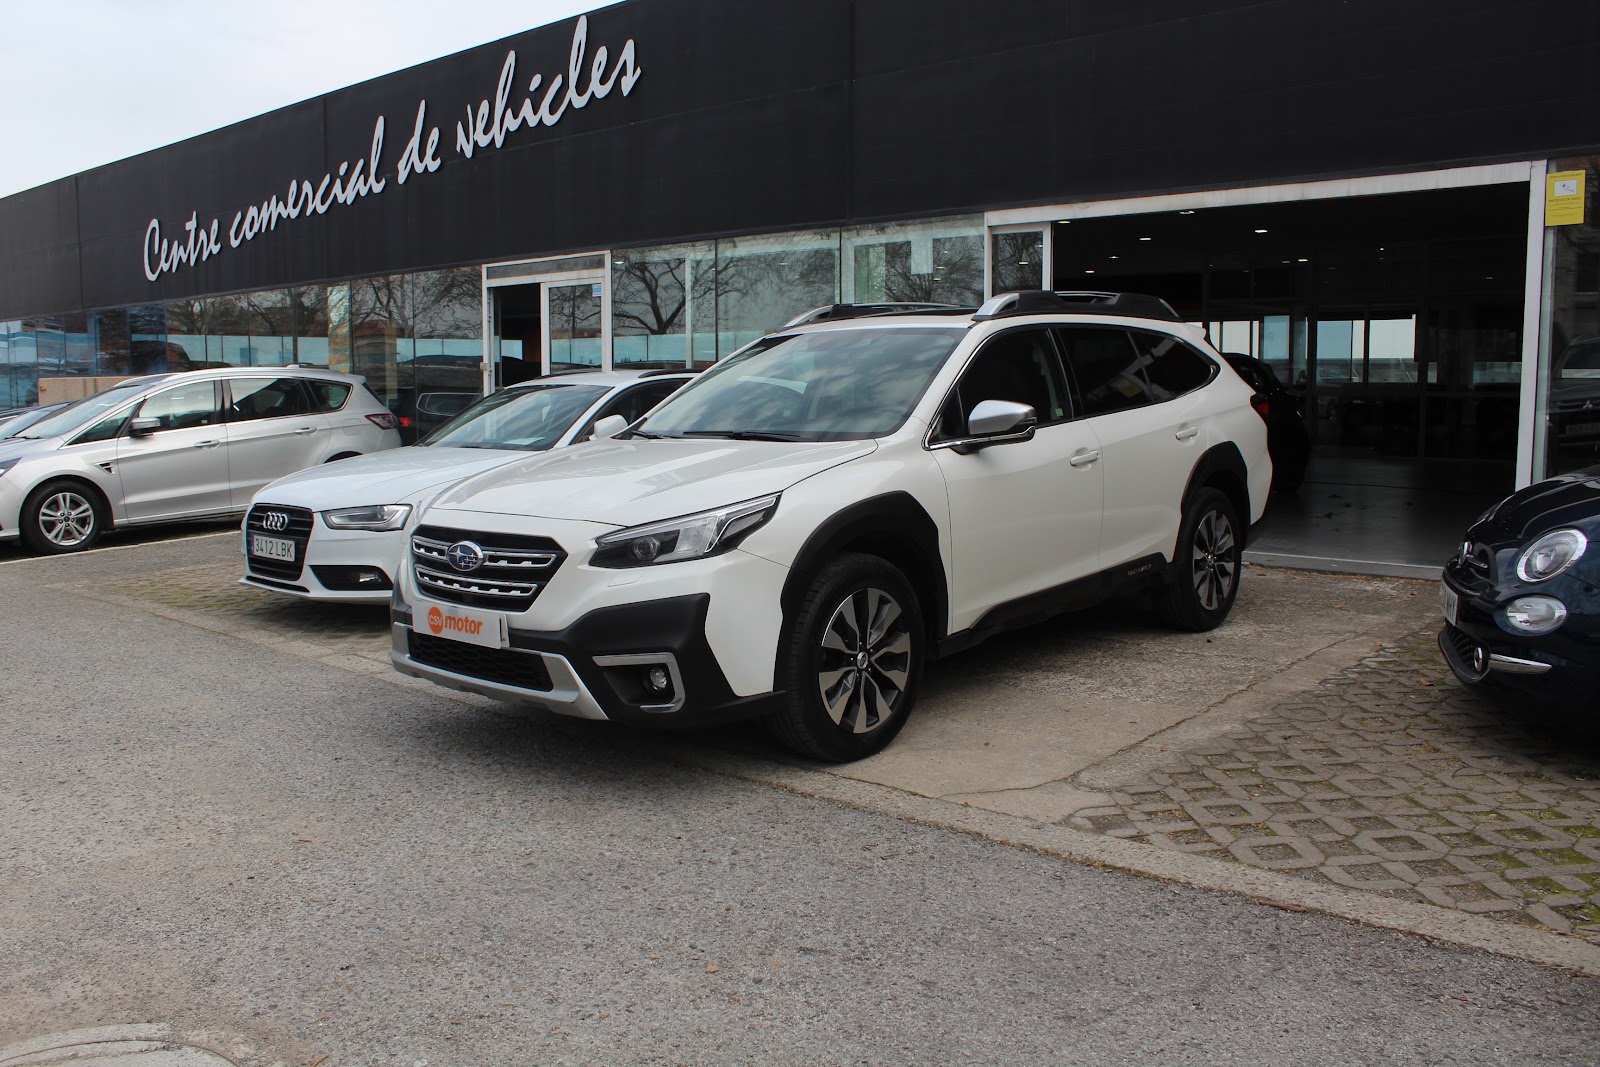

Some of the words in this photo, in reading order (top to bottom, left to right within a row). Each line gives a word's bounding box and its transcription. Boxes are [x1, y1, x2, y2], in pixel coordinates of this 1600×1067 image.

[143, 211, 222, 282] Centre
[229, 115, 386, 249] comercial
[398, 99, 442, 185] de
[456, 14, 642, 159] vehicles
[255, 538, 274, 555] 3412
[276, 541, 293, 559] LBK
[445, 615, 483, 635] motor
